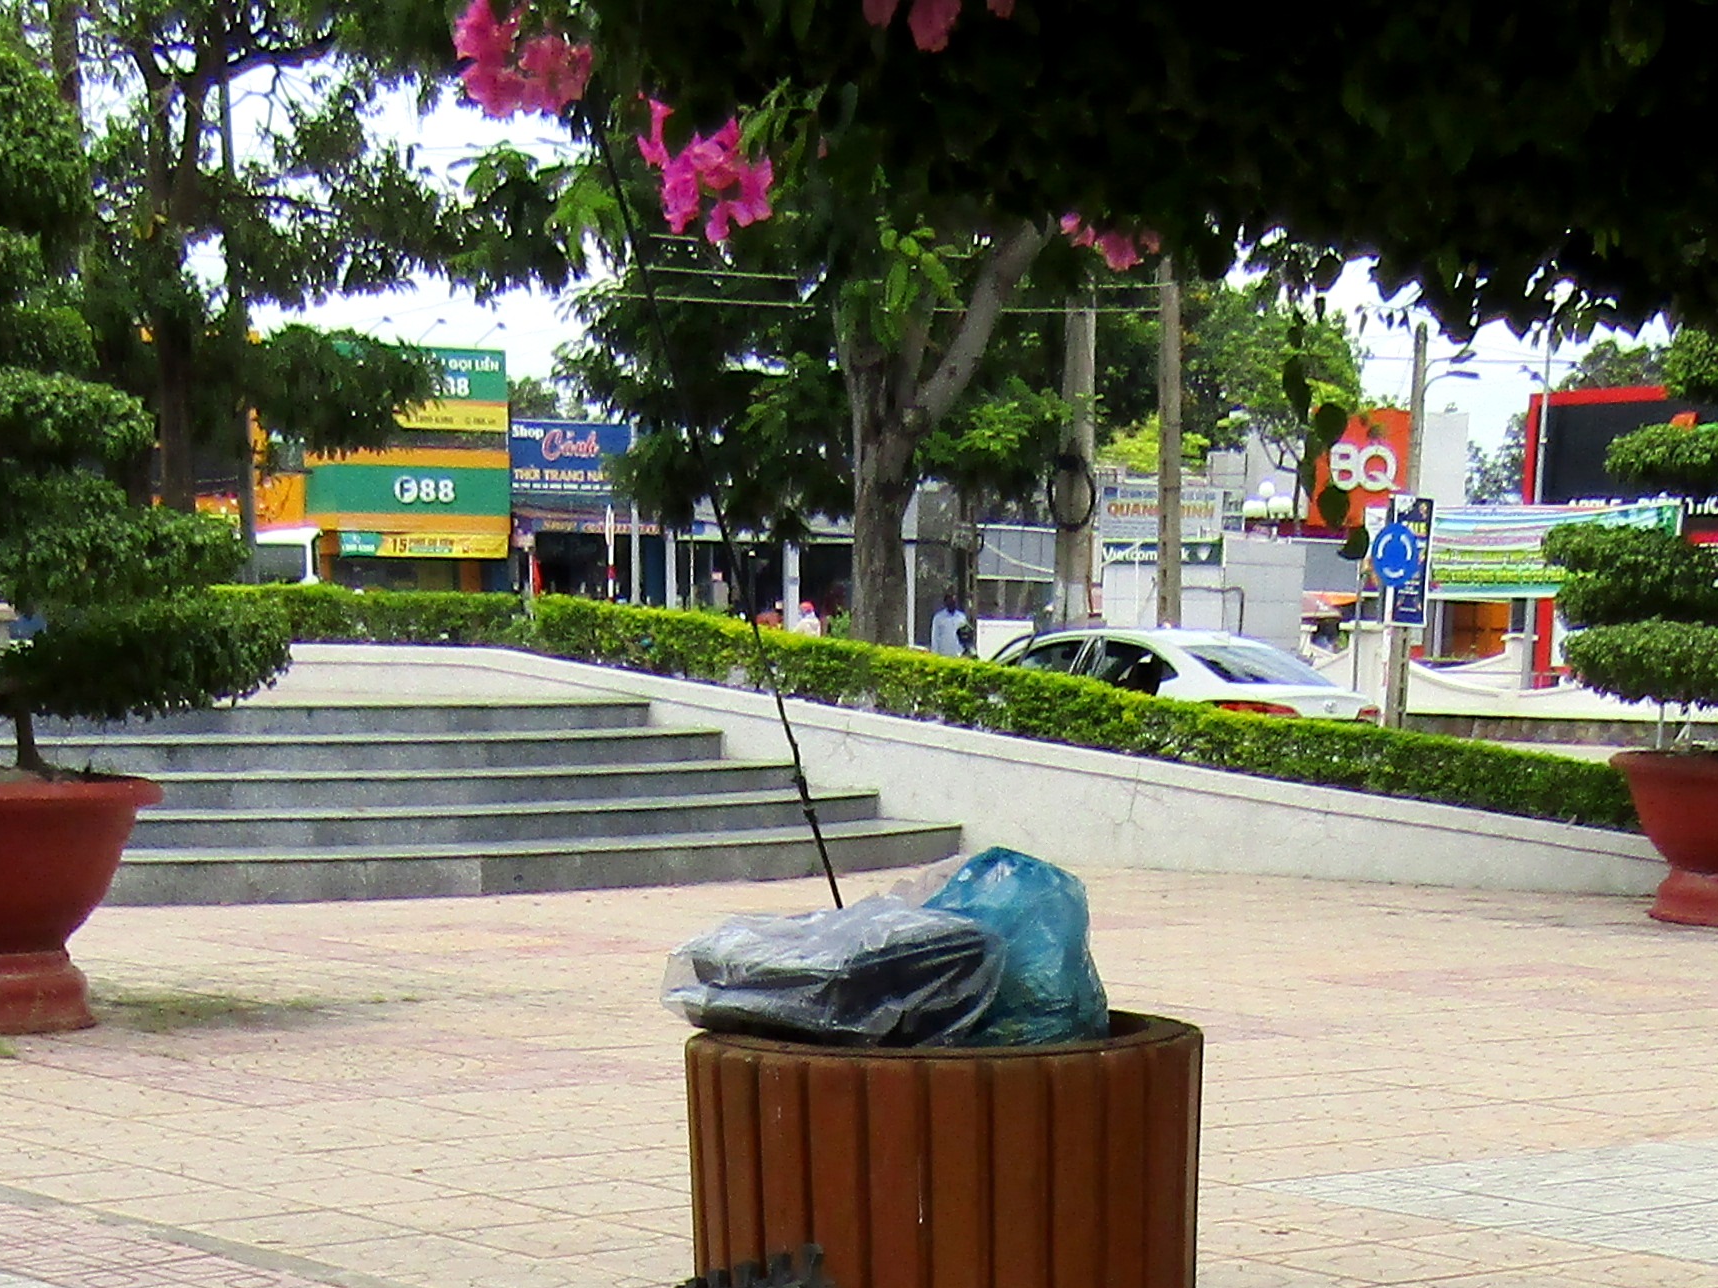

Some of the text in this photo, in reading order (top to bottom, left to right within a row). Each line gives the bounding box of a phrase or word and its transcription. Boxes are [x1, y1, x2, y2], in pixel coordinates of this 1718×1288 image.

[511, 424, 544, 440] Shop
[1330, 443, 1400, 491] BQ
[394, 475, 456, 504] F88
